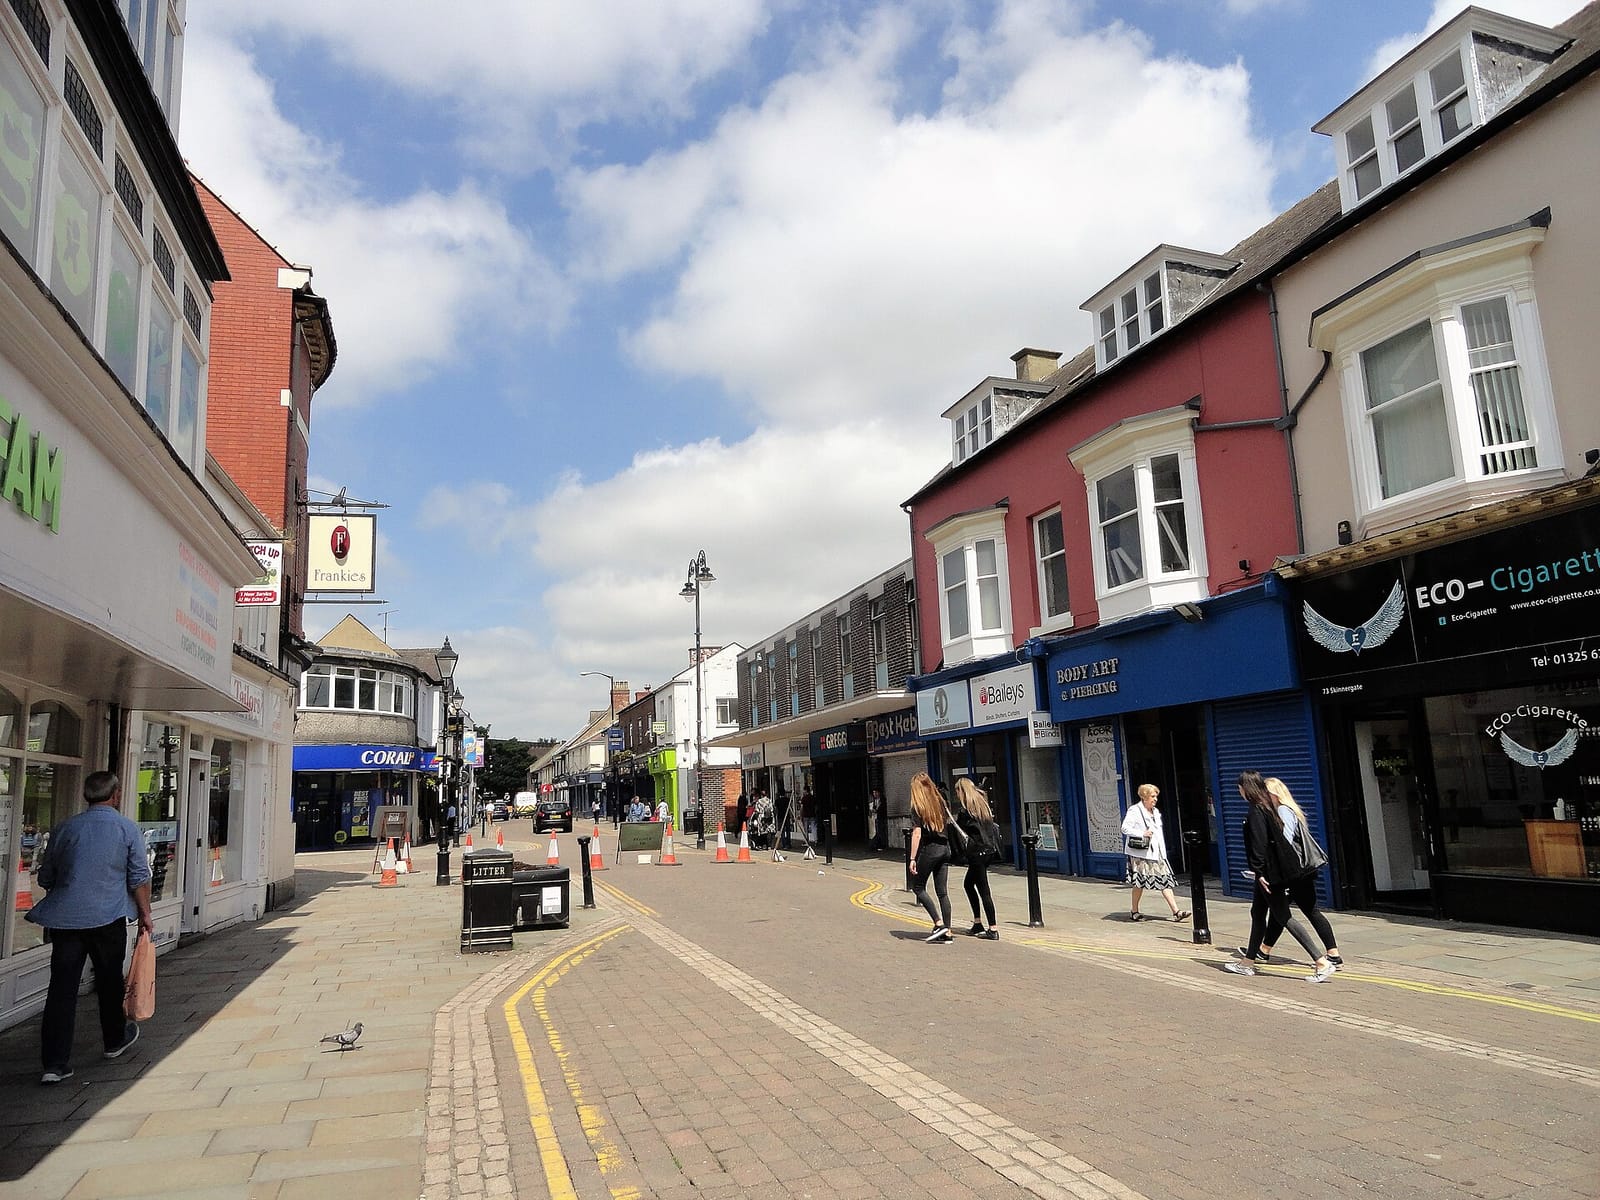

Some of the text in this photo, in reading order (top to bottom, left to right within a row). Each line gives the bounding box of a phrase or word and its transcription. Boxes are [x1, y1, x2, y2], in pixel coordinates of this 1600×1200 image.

[268, 547, 280, 559] UP
[314, 569, 366, 582] Frankies
[1451, 607, 1497, 622] Eco-Cigarette
[1553, 650, 1588, 665] 01325
[1056, 658, 1118, 684] BODY ART
[988, 682, 1024, 704] Baileys
[1070, 681, 1118, 699] PIERCING
[1330, 684, 1363, 695] Skinnergate
[1485, 704, 1588, 738] ECO-Cigarette
[826, 731, 848, 749] GREGG
[1040, 730, 1060, 738] Blinds
[361, 750, 411, 765] CORAL
[472, 866, 506, 877] LITTER
